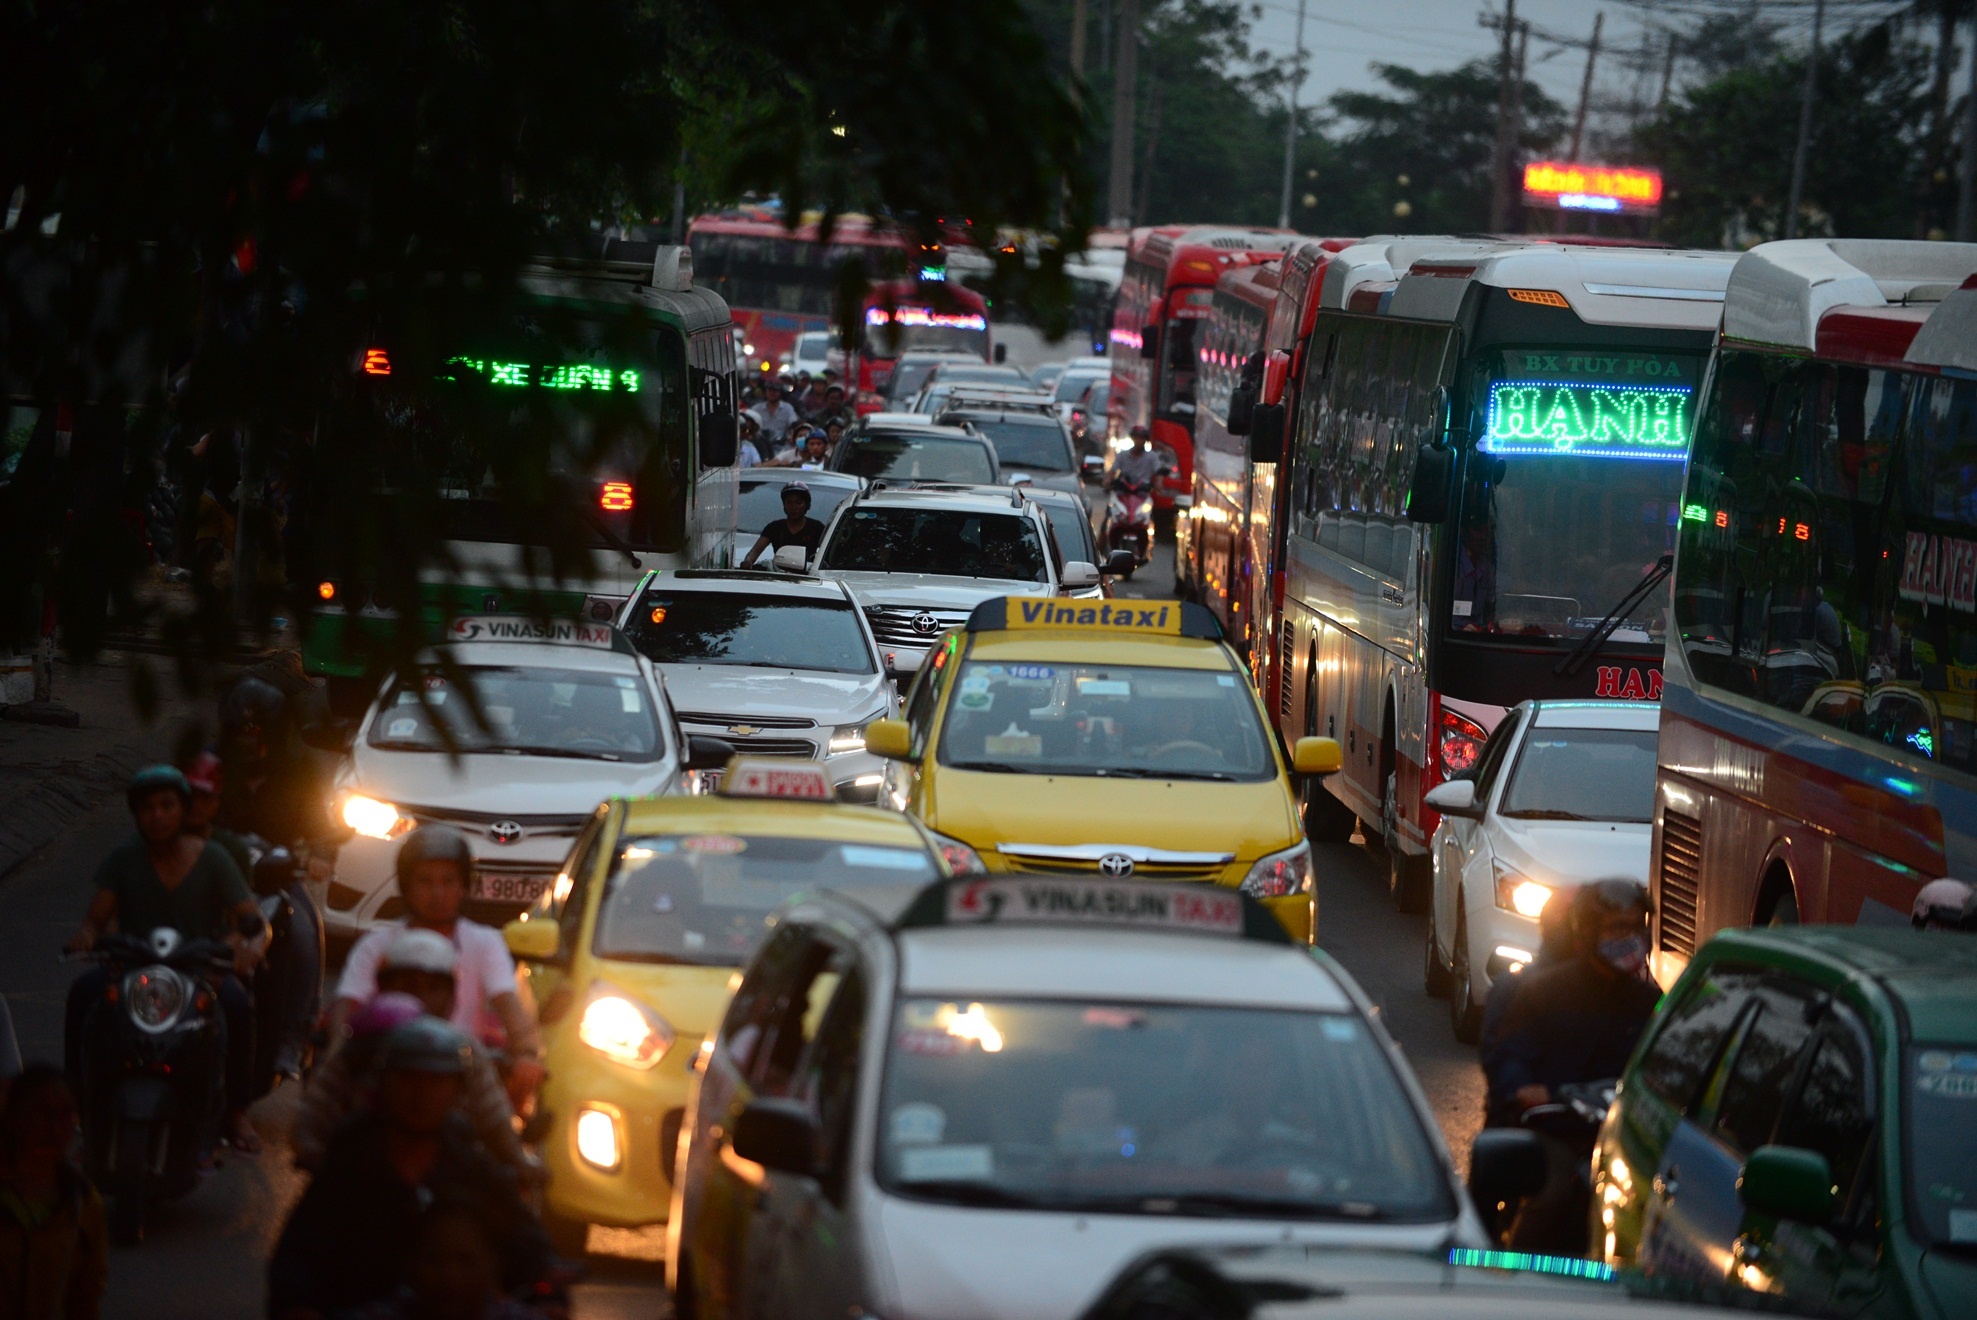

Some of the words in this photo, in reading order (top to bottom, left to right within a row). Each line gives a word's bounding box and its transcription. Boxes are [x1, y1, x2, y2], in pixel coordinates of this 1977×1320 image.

[491, 361, 530, 385] XE
[1525, 355, 1560, 372] BX
[1567, 356, 1620, 374] TUY
[1021, 601, 1168, 627] Vinataxi
[488, 622, 571, 640] VINASUN
[574, 625, 610, 643] TAXI
[1009, 665, 1050, 680] 1666
[1020, 884, 1170, 918] VINASUN
[1172, 890, 1242, 925] TAXI
